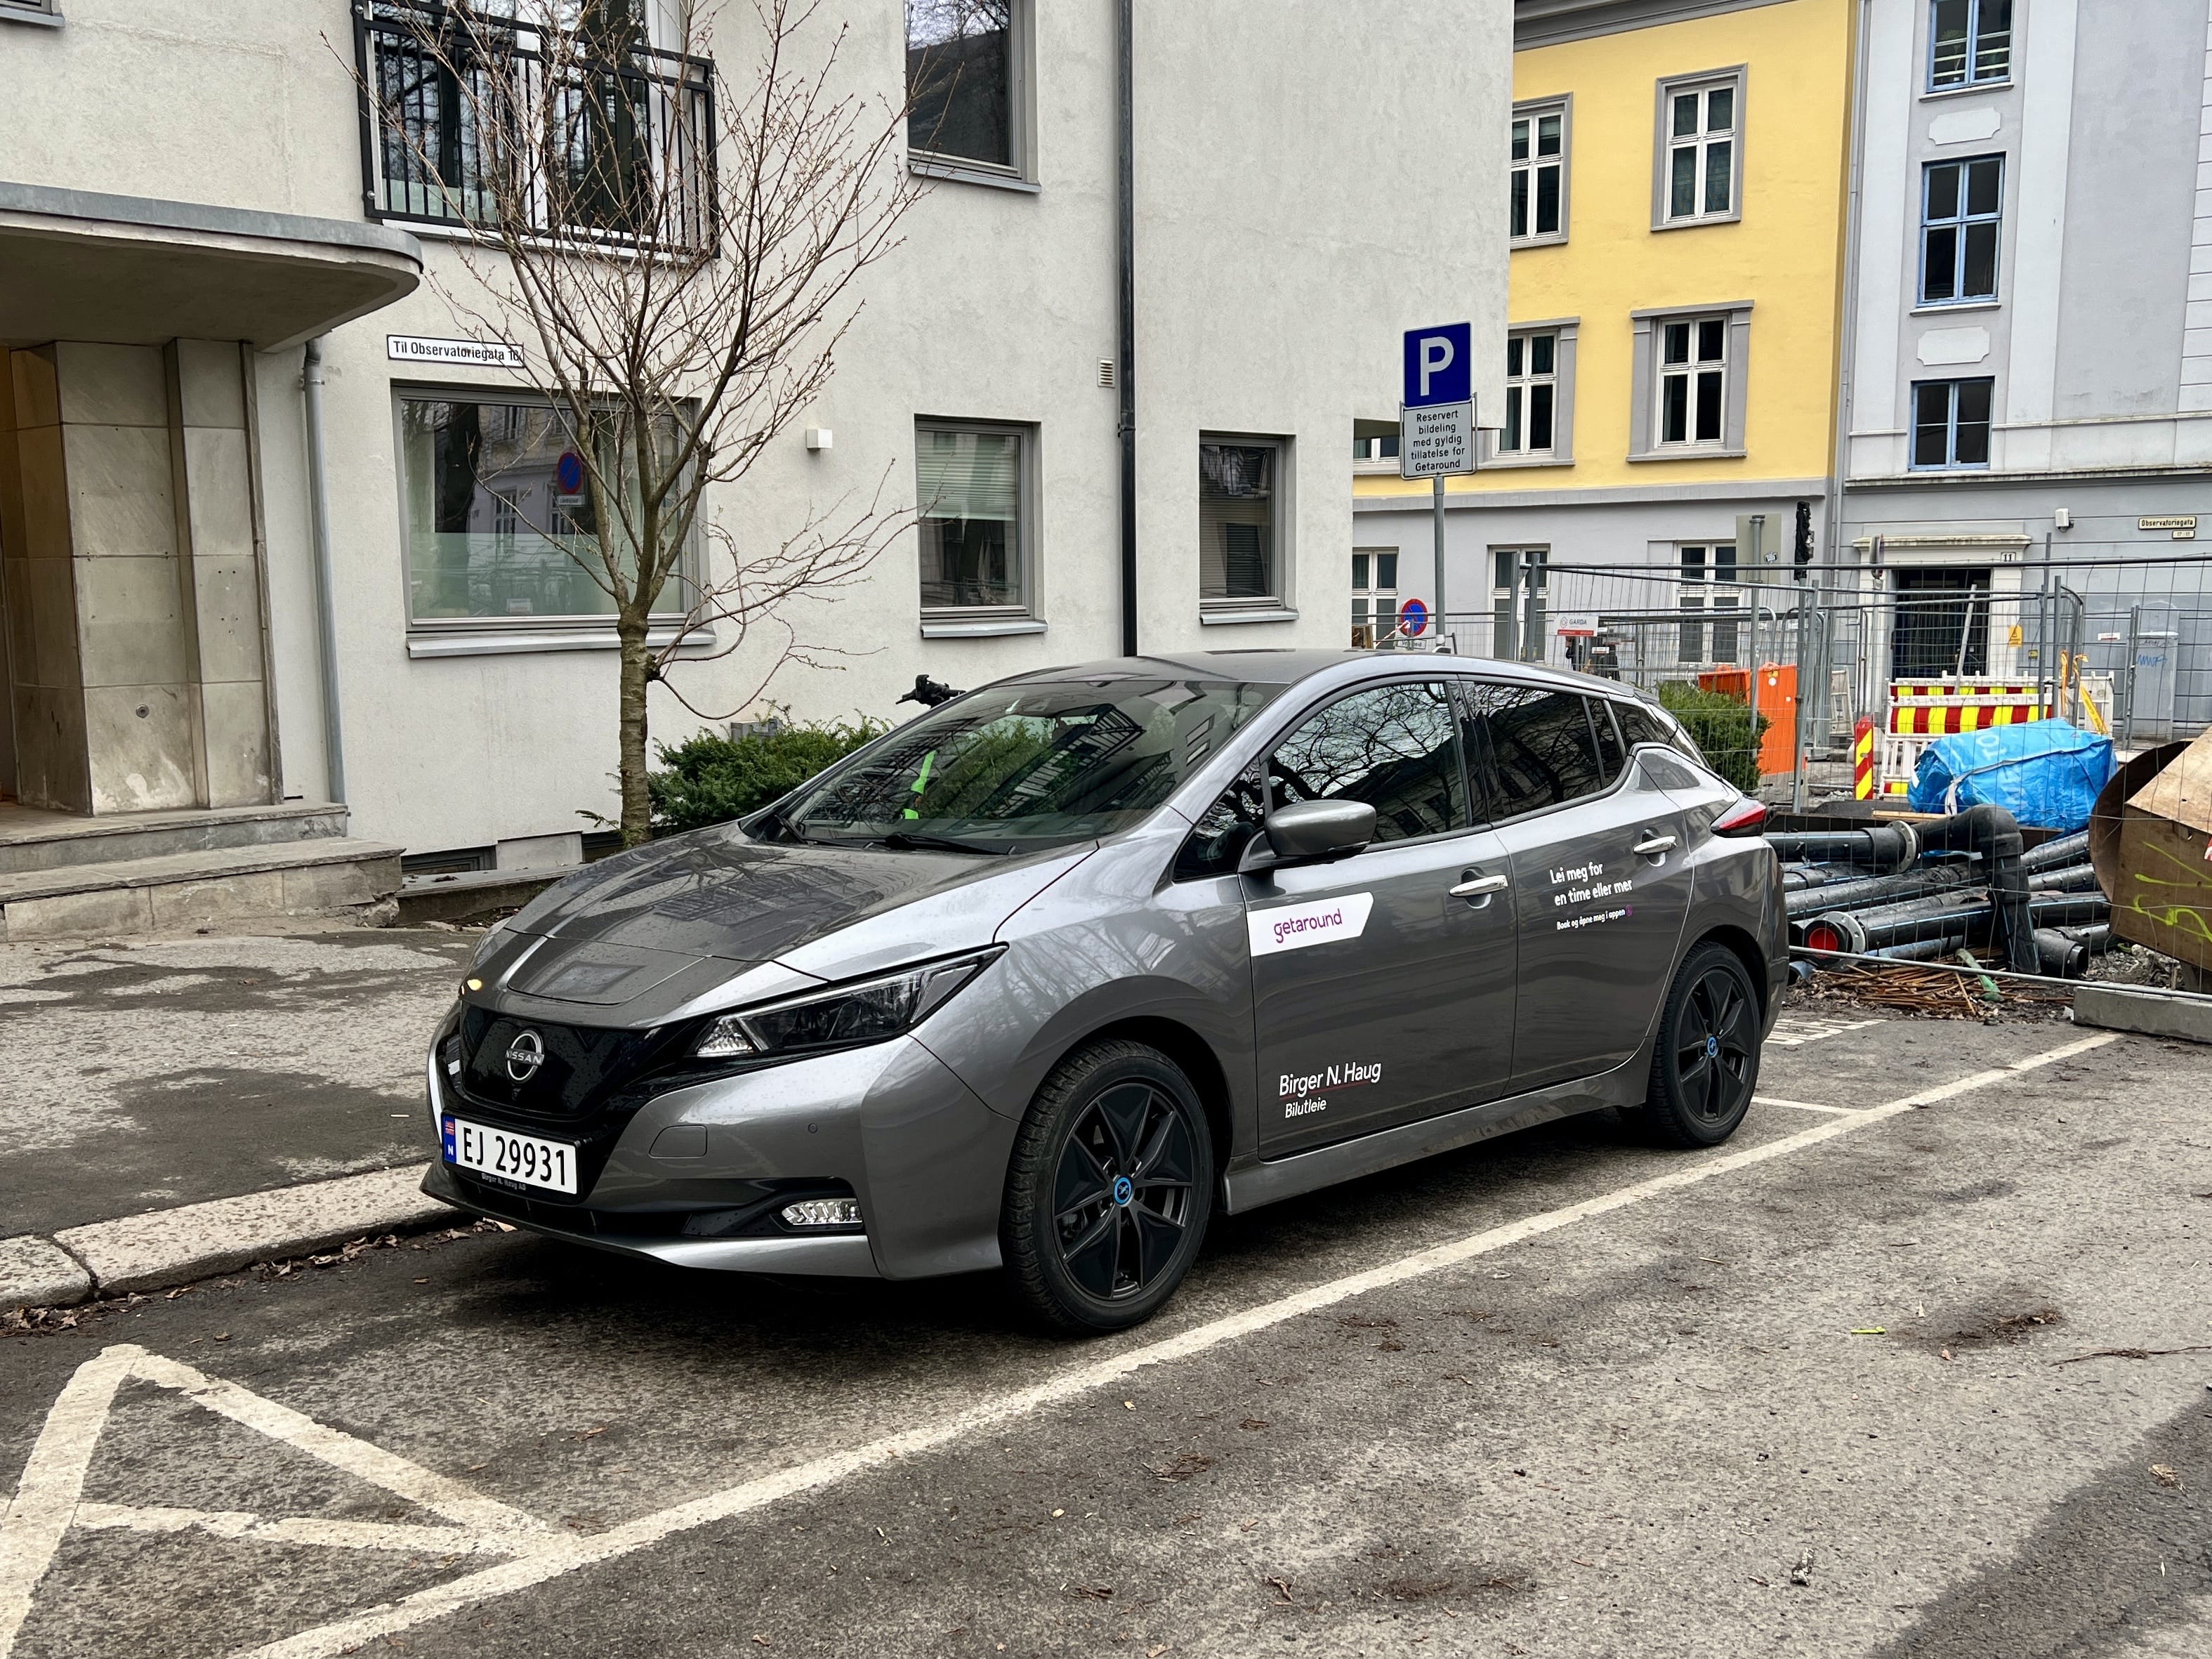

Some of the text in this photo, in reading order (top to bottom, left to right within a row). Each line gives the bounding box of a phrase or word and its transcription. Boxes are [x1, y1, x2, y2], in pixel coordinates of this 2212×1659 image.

[393, 341, 407, 353] Til
[411, 341, 505, 362] Observatoriegata
[1420, 336, 1454, 397] P
[1416, 409, 1459, 422] Reservert
[1418, 423, 1456, 435] bildeling
[1413, 434, 1462, 447] med gyldig
[1411, 446, 1466, 460] tillatelse for
[1415, 459, 1461, 471] Getaround
[1549, 861, 1603, 884] Lei meg for
[1554, 879, 1633, 906] en time eller mer
[1273, 907, 1343, 943] getaround
[1556, 919, 1571, 930] Book
[1571, 919, 1579, 929] og
[1593, 913, 1605, 923] meg
[1608, 909, 1626, 920] appen
[506, 1049, 542, 1064] NISSAN
[1279, 1061, 1382, 1098] Birger N. Haug
[1285, 1096, 1327, 1119] Bilutleie
[447, 1144, 454, 1155] N
[463, 1127, 565, 1186] EJ 29931
